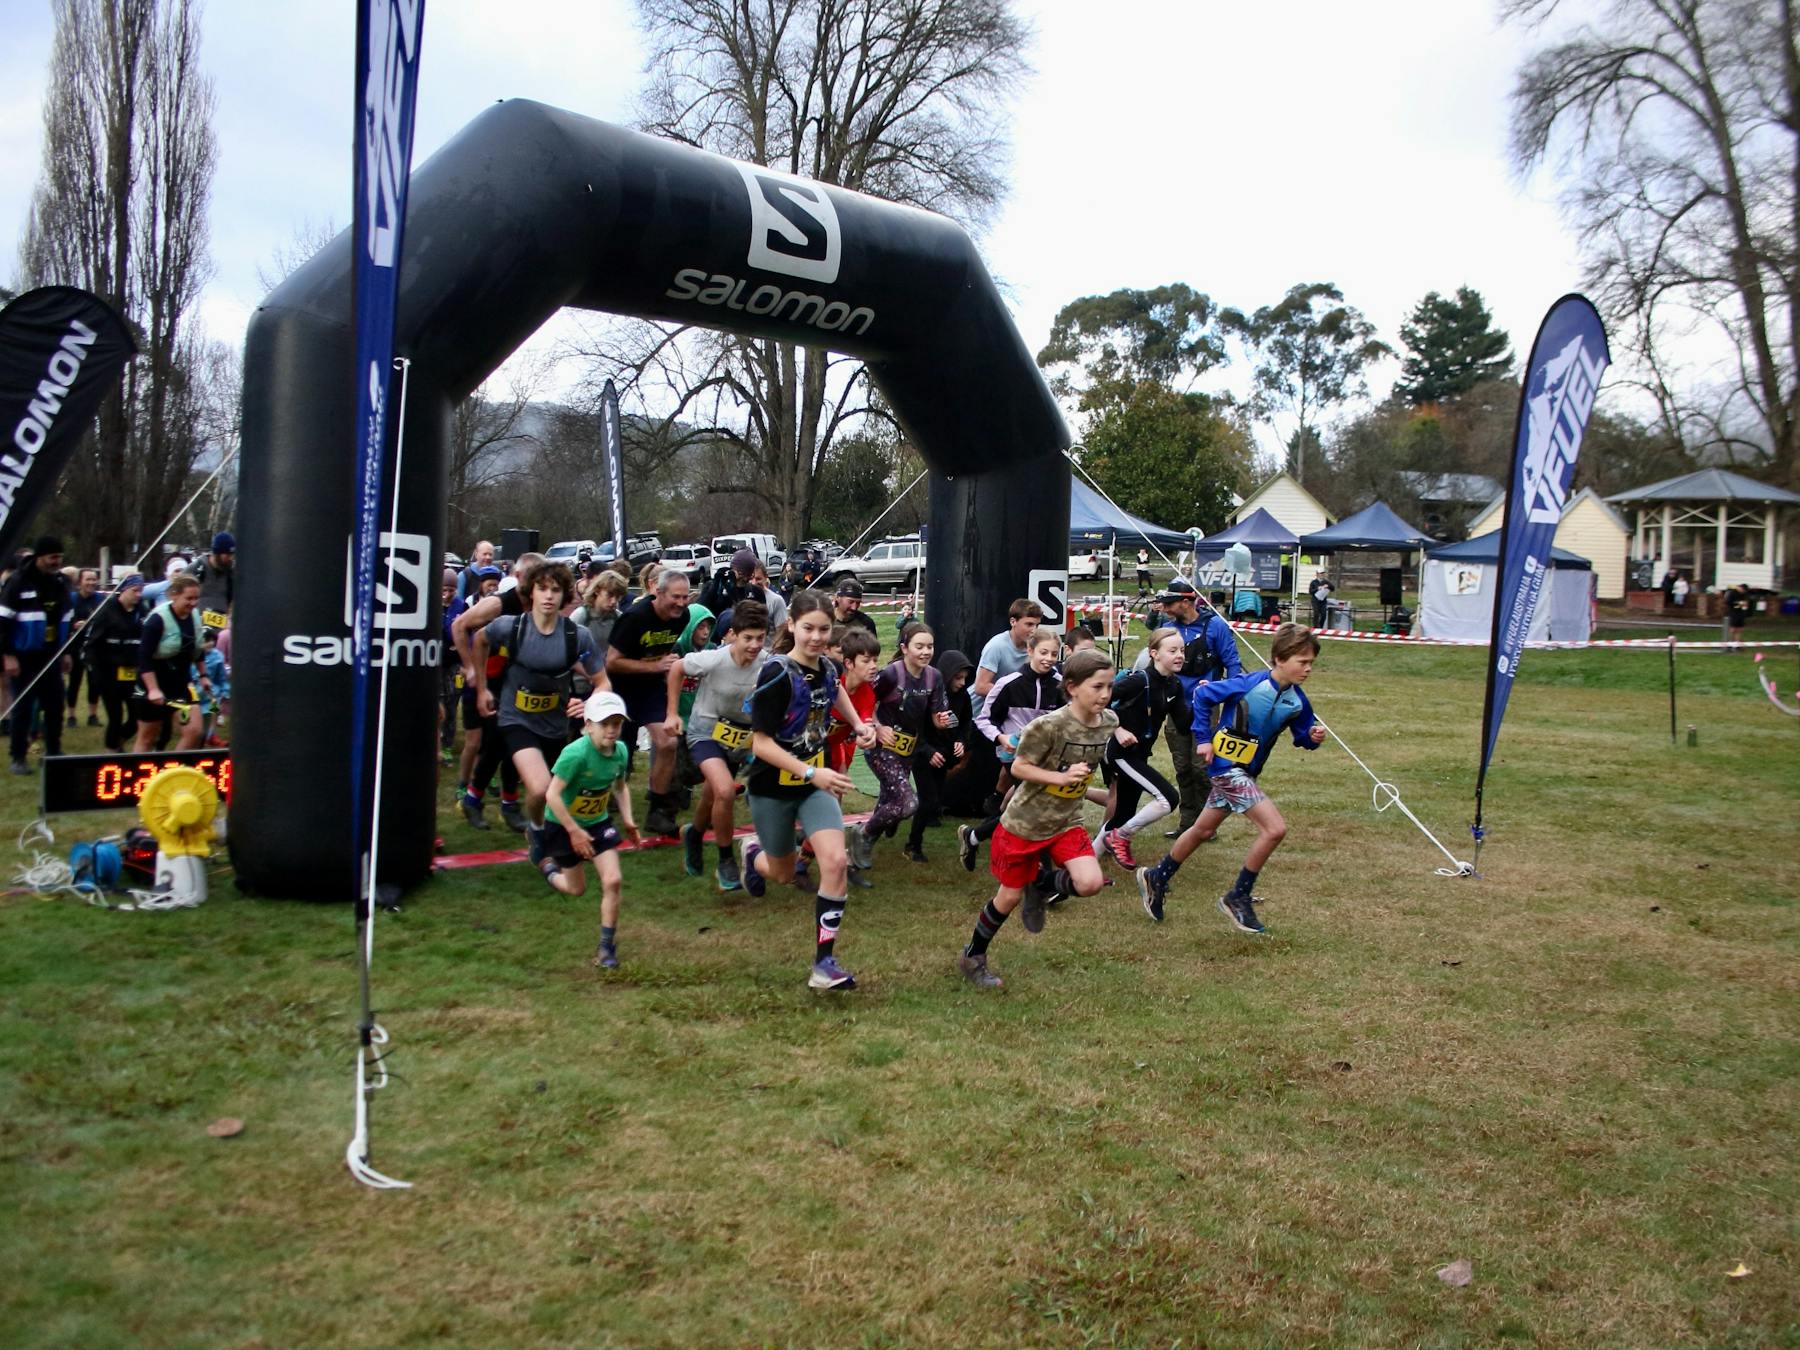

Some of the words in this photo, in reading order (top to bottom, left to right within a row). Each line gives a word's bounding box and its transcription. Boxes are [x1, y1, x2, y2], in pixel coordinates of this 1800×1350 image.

[664, 268, 876, 336] salomon
[1528, 345, 1606, 524] VFUEL
[604, 400, 622, 557] SALOMON
[206, 613, 222, 626] 143
[523, 696, 551, 710] 198
[1218, 737, 1248, 758] 197
[577, 796, 607, 815] 220
